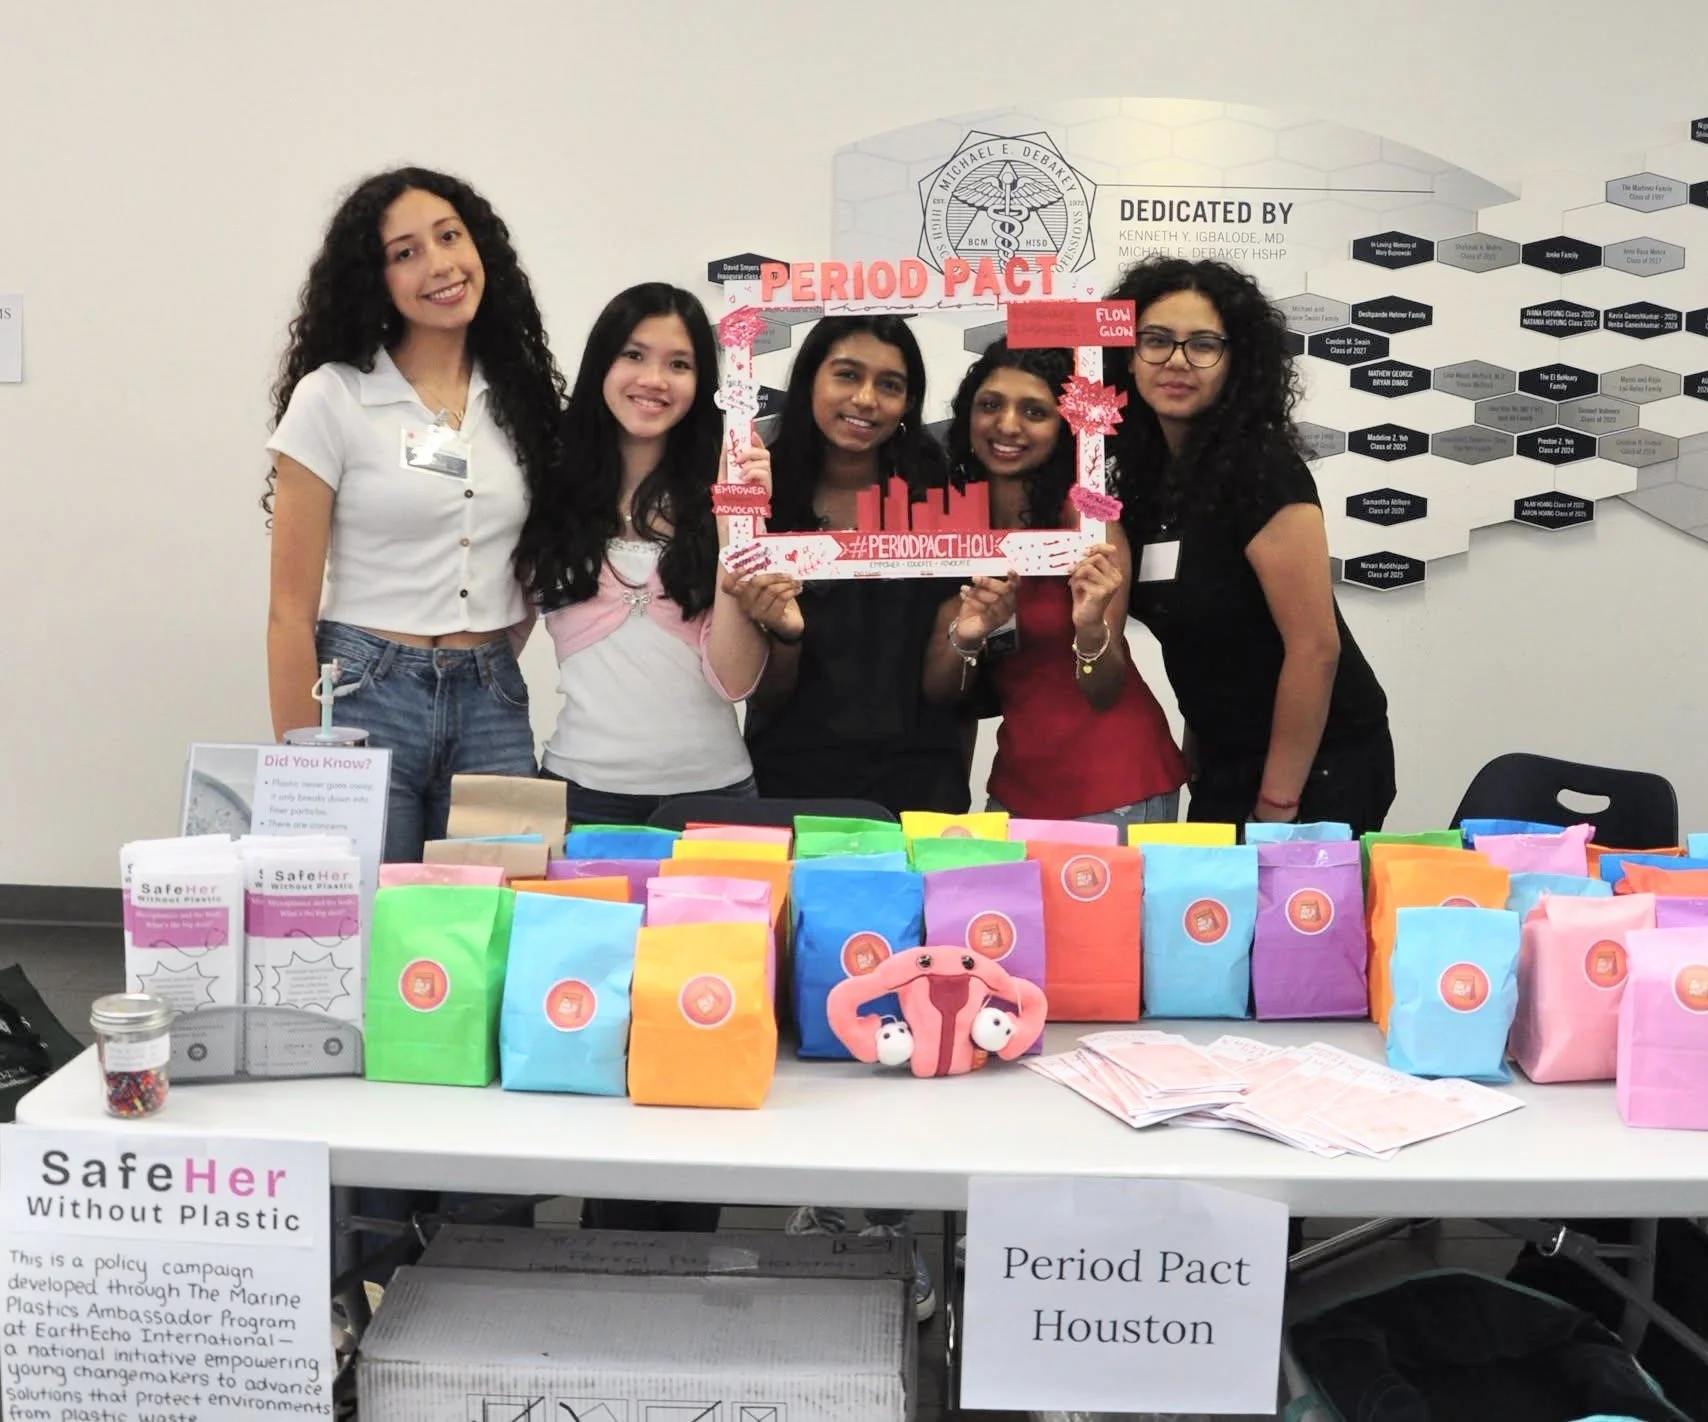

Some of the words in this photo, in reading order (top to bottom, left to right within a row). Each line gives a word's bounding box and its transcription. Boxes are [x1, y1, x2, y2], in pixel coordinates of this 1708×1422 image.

[939, 146, 995, 191] MICHAEL
[1002, 144, 1014, 155] E.
[1023, 146, 1077, 192] DEBAKEY
[1120, 199, 1252, 223] DEDICATED
[1262, 202, 1293, 225] BY
[932, 209, 943, 240] HIGH
[1026, 239, 1048, 247] HISD
[1119, 230, 1178, 242] KENNETH
[1180, 232, 1191, 242] Y.
[1195, 232, 1260, 244] IGBALODE,
[1264, 233, 1285, 244] MD
[1118, 247, 1174, 258] MICHAEL
[1178, 247, 1188, 258] E.
[1192, 247, 1248, 260] DEBAKEY
[1253, 249, 1287, 260] HSHP
[723, 264, 739, 272] David
[760, 259, 928, 303] PERIOD
[944, 256, 1057, 298] PACT
[1096, 308, 1131, 323] FLOW
[1408, 311, 1426, 320] Family
[1100, 326, 1134, 337] GLOW
[1368, 370, 1391, 378] MATHEW
[1392, 370, 1414, 378] GEORGE
[1550, 382, 1567, 391] Family
[714, 485, 767, 496] EMPOWER
[716, 505, 768, 516] ADVOCATE
[849, 534, 995, 559] #PERIODPACTHOU
[264, 755, 289, 769] Did
[292, 756, 319, 769] You
[323, 757, 372, 770] Know?
[268, 819, 291, 829] There
[275, 870, 349, 882] SafeHer
[141, 884, 218, 895] SafeHer
[271, 883, 313, 891] Without
[42, 1150, 286, 1198] SafeHer
[27, 1196, 163, 1224] Without
[180, 1204, 301, 1232] Plastic
[9, 1249, 43, 1268] This
[51, 1254, 65, 1268] is
[73, 1257, 84, 1268] a
[95, 1255, 147, 1284] policy
[162, 1262, 254, 1288] campaign
[1003, 1246, 1142, 1283] Period
[1158, 1251, 1251, 1286] Pact
[8, 1274, 97, 1298] developed
[107, 1280, 181, 1307] through
[188, 1283, 221, 1302] The
[230, 1287, 301, 1310] Marine
[6, 1297, 79, 1318] Plastics
[87, 1303, 213, 1326] Ambassador
[221, 1309, 296, 1334] Program
[4, 1320, 26, 1337] at
[36, 1322, 132, 1342] EarthEcho
[1033, 1309, 1215, 1345] Houston
[5, 1344, 17, 1356] a
[28, 1343, 105, 1361] national
[114, 1348, 197, 1366] initiative
[204, 1353, 320, 1382] empowering
[8, 1362, 66, 1386] young
[73, 1365, 209, 1388] changemakers
[218, 1373, 237, 1389] to
[244, 1377, 323, 1397] advance
[88, 1388, 128, 1404] that
[135, 1391, 201, 1408] protect
[208, 1394, 332, 1416] environments
[9, 1404, 51, 1421] from
[61, 1408, 128, 1422] plastic
